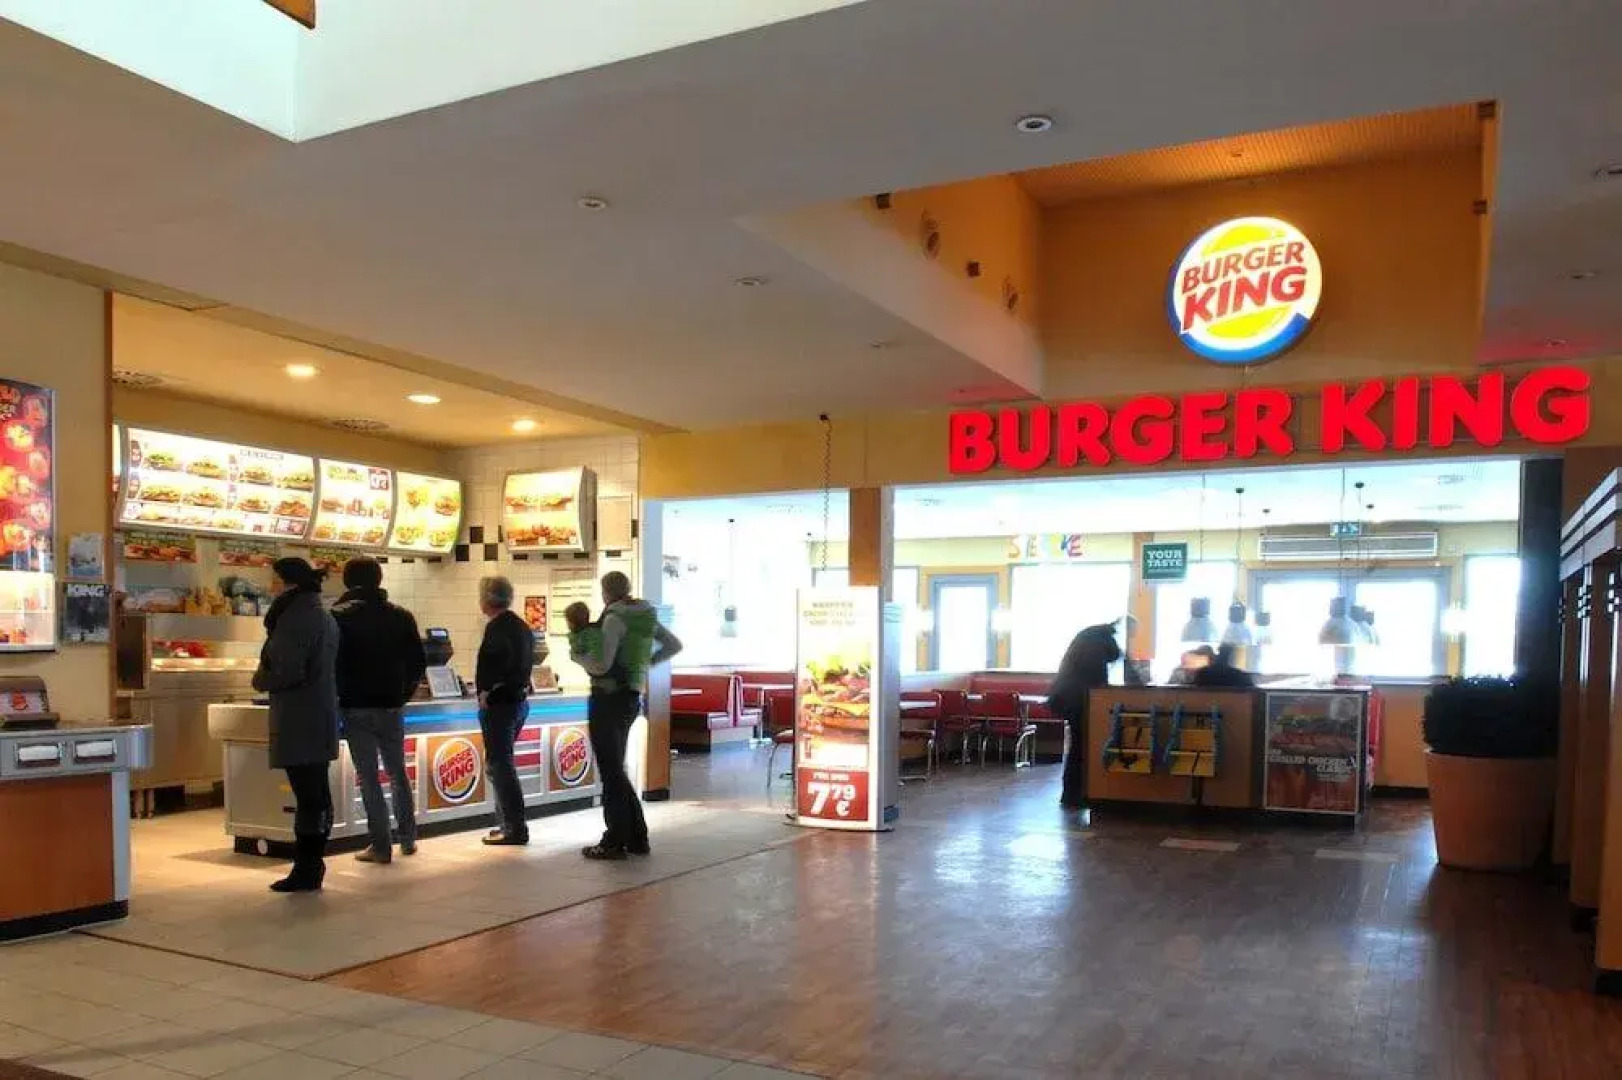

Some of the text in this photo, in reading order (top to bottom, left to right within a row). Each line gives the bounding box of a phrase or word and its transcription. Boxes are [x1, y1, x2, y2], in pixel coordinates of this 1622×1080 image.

[1182, 241, 1304, 294] BURGER
[1183, 265, 1307, 331] KING
[948, 366, 1590, 474] BURGER KING
[1147, 549, 1183, 560] YOUR
[1147, 559, 1183, 568] TASTE
[439, 748, 473, 776] BURGER
[441, 758, 475, 791] KING
[560, 746, 587, 775] KING
